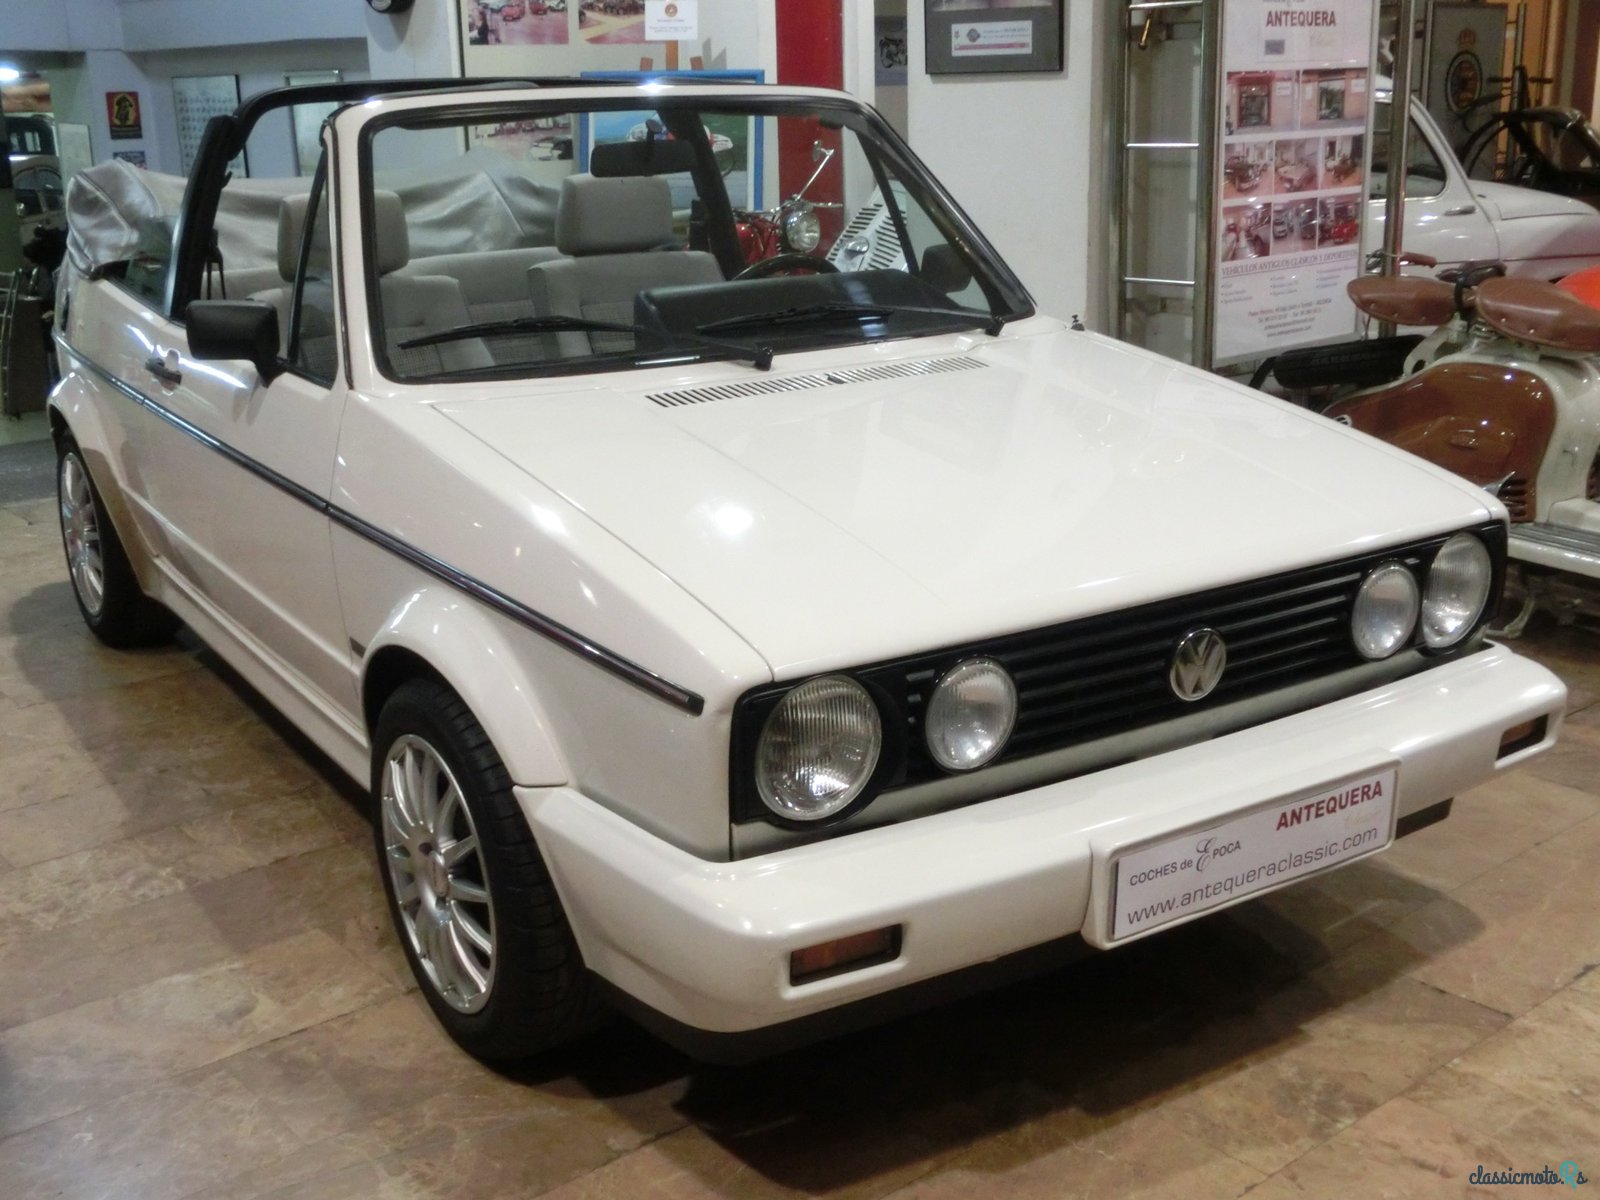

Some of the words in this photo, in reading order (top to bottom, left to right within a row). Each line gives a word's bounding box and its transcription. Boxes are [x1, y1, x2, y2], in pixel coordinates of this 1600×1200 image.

[1266, 10, 1336, 27] ANTEQUERA
[1276, 780, 1382, 831] ANTEQUERA
[1128, 827, 1377, 925] www.antequeraclassic.com
[1130, 861, 1178, 886] COCHES
[1180, 858, 1193, 871] de
